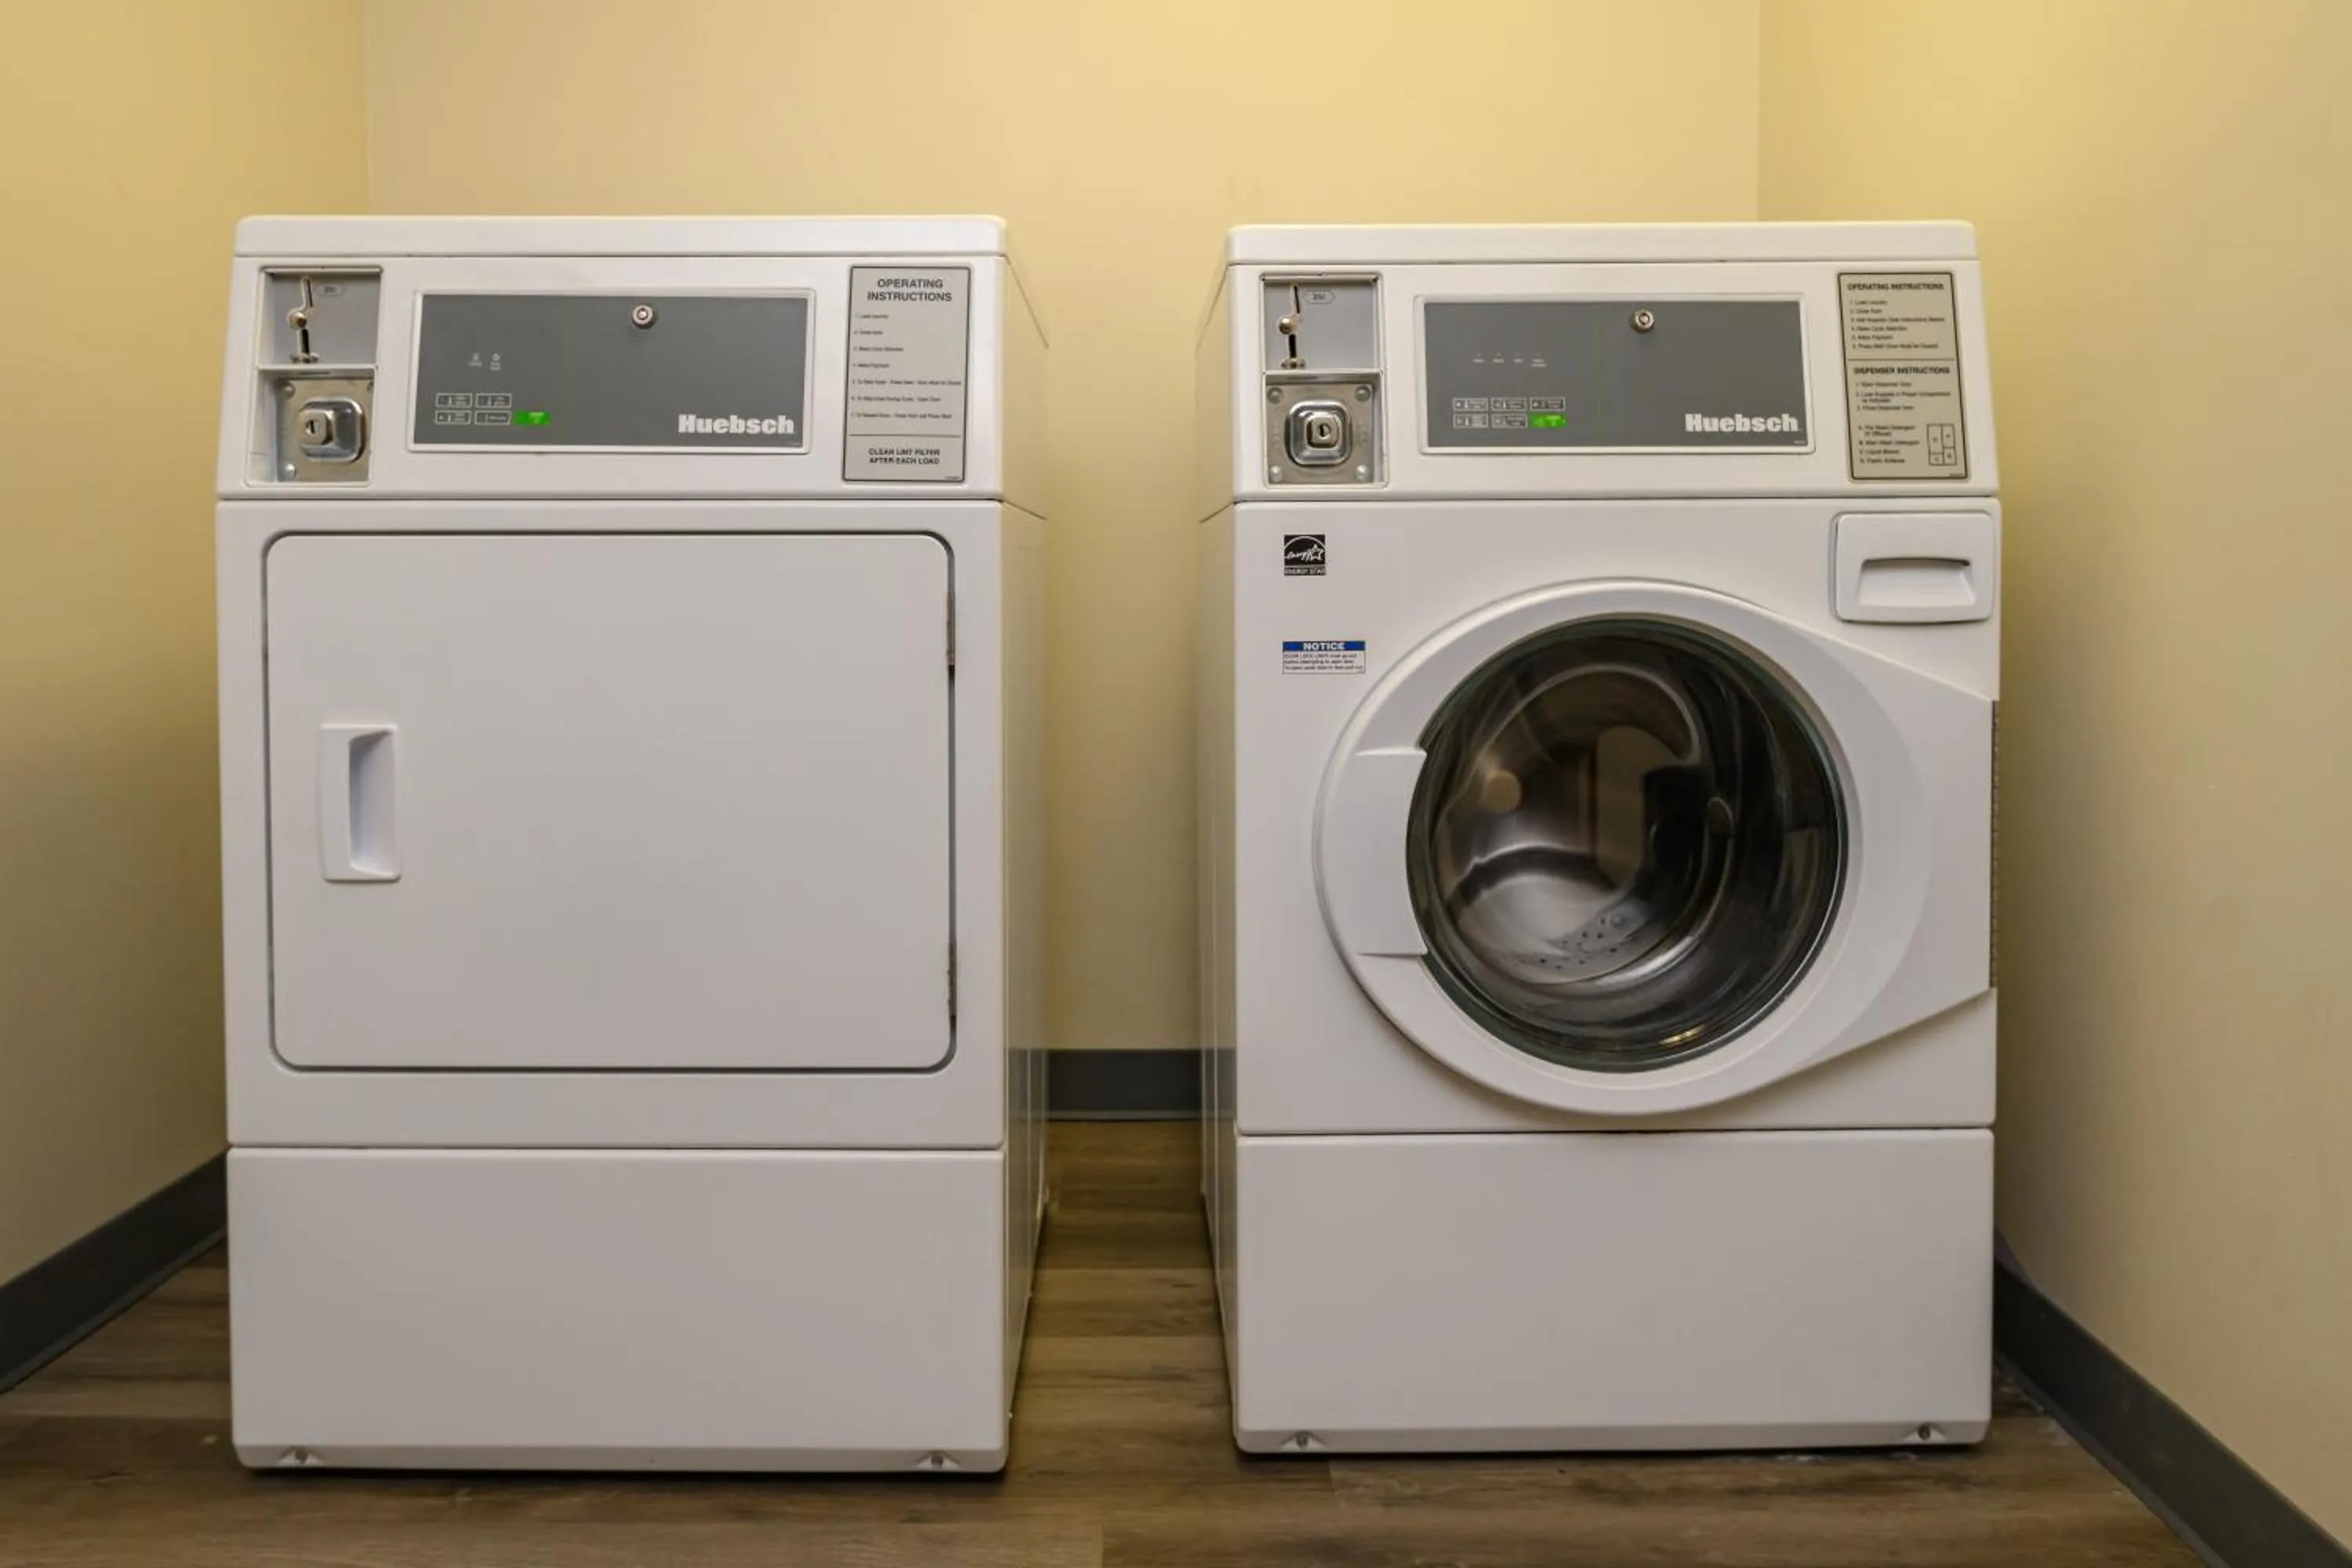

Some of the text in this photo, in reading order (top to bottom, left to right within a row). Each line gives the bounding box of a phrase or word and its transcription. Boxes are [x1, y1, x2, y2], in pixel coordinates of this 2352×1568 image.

[877, 278, 943, 289] OPERATING
[867, 292, 952, 301] INSTRUCTIONS
[678, 413, 794, 434] Huebsch
[1685, 413, 1798, 432] Huebsch
